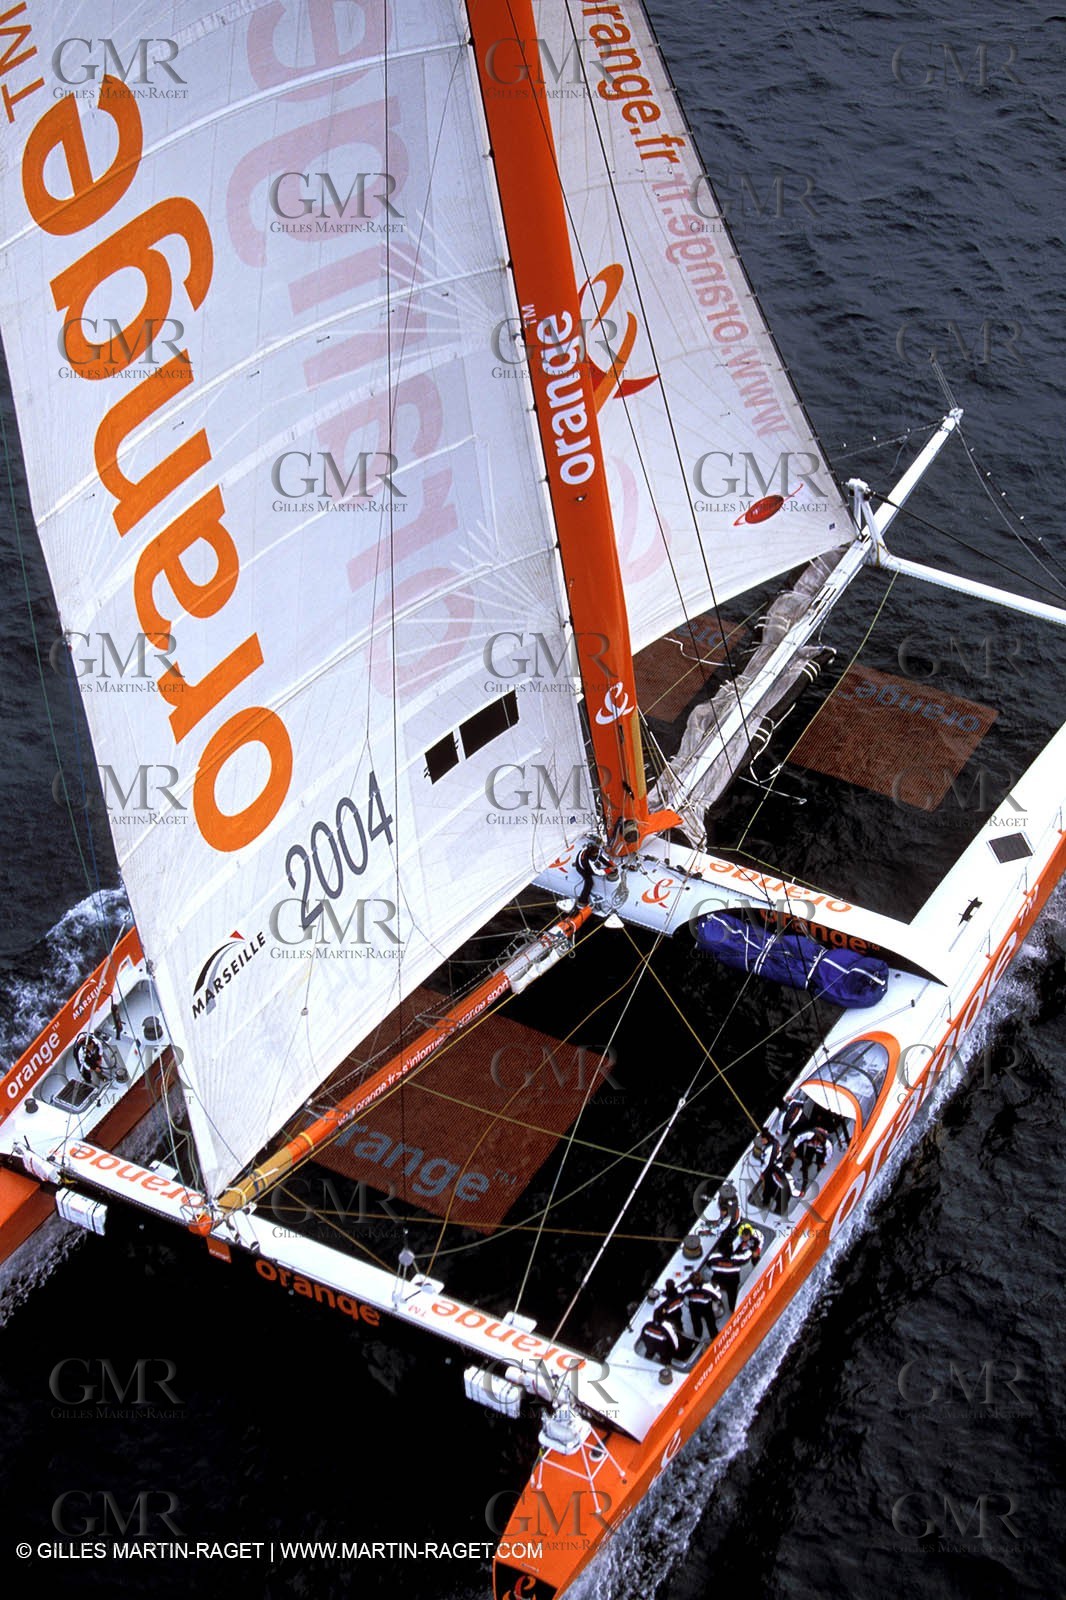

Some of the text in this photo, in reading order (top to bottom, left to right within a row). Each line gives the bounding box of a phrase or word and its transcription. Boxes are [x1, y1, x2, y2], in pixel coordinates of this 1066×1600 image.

[581, 0, 686, 164] range.fr
[537, 310, 596, 485] orange
[22, 74, 292, 853] orange
[854, 680, 981, 733] orange
[285, 770, 394, 931] 2004
[709, 860, 852, 913] orange
[760, 908, 868, 955] orange
[192, 931, 266, 1019] MARSEILLE
[7, 1032, 61, 1098] orange
[69, 1142, 206, 1209] orange
[334, 1122, 489, 1202] range
[255, 1259, 381, 1328] orange
[431, 1299, 587, 1371] orange
[694, 1363, 714, 1391] votre
[714, 1330, 740, 1363] mobile
